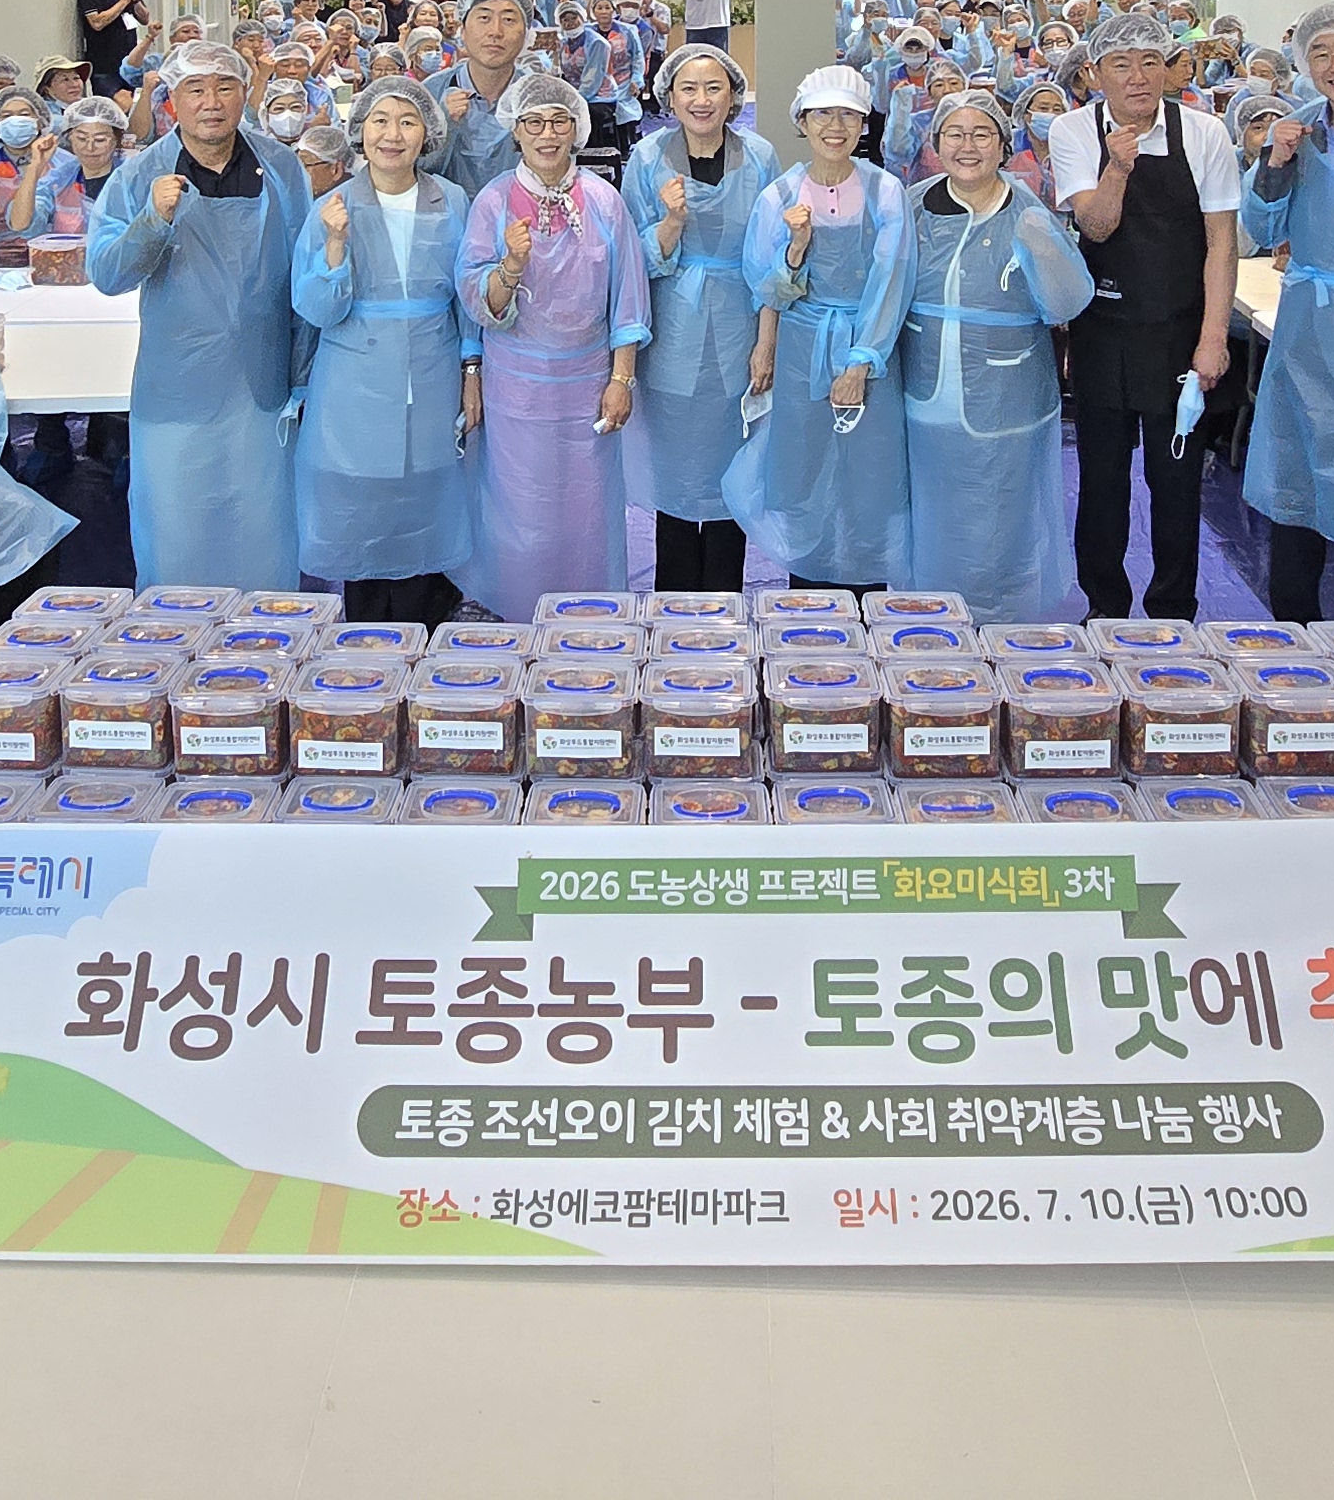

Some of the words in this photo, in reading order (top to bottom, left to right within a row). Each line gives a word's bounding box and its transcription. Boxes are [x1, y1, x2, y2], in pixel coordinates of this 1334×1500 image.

[539, 870, 619, 900] 2026
[627, 868, 751, 906] 도농상생
[757, 868, 881, 906] 프로젝트
[1064, 866, 1115, 900] 3차
[36, 907, 60, 916] CITY
[63, 951, 330, 1062] 화성시
[355, 955, 715, 1064] 토종농부
[804, 951, 1074, 1065] 토종의
[1096, 950, 1284, 1061] 맛에
[395, 1099, 474, 1147] 토종
[481, 1097, 636, 1146] 조선오이
[648, 1097, 722, 1147] 김치
[733, 1097, 810, 1147] 체험
[821, 1101, 850, 1140] &
[859, 1097, 936, 1143] 사회
[947, 1095, 1104, 1146] 취약계층
[1114, 1095, 1194, 1144] 나눔
[1199, 1094, 1282, 1143] 행사
[396, 1187, 461, 1228] 장소
[490, 1187, 790, 1228] 화성에코팜테마파크
[833, 1187, 899, 1227] 일시
[929, 1189, 1030, 1222] 2026.
[1204, 1186, 1308, 1219] 10:00
